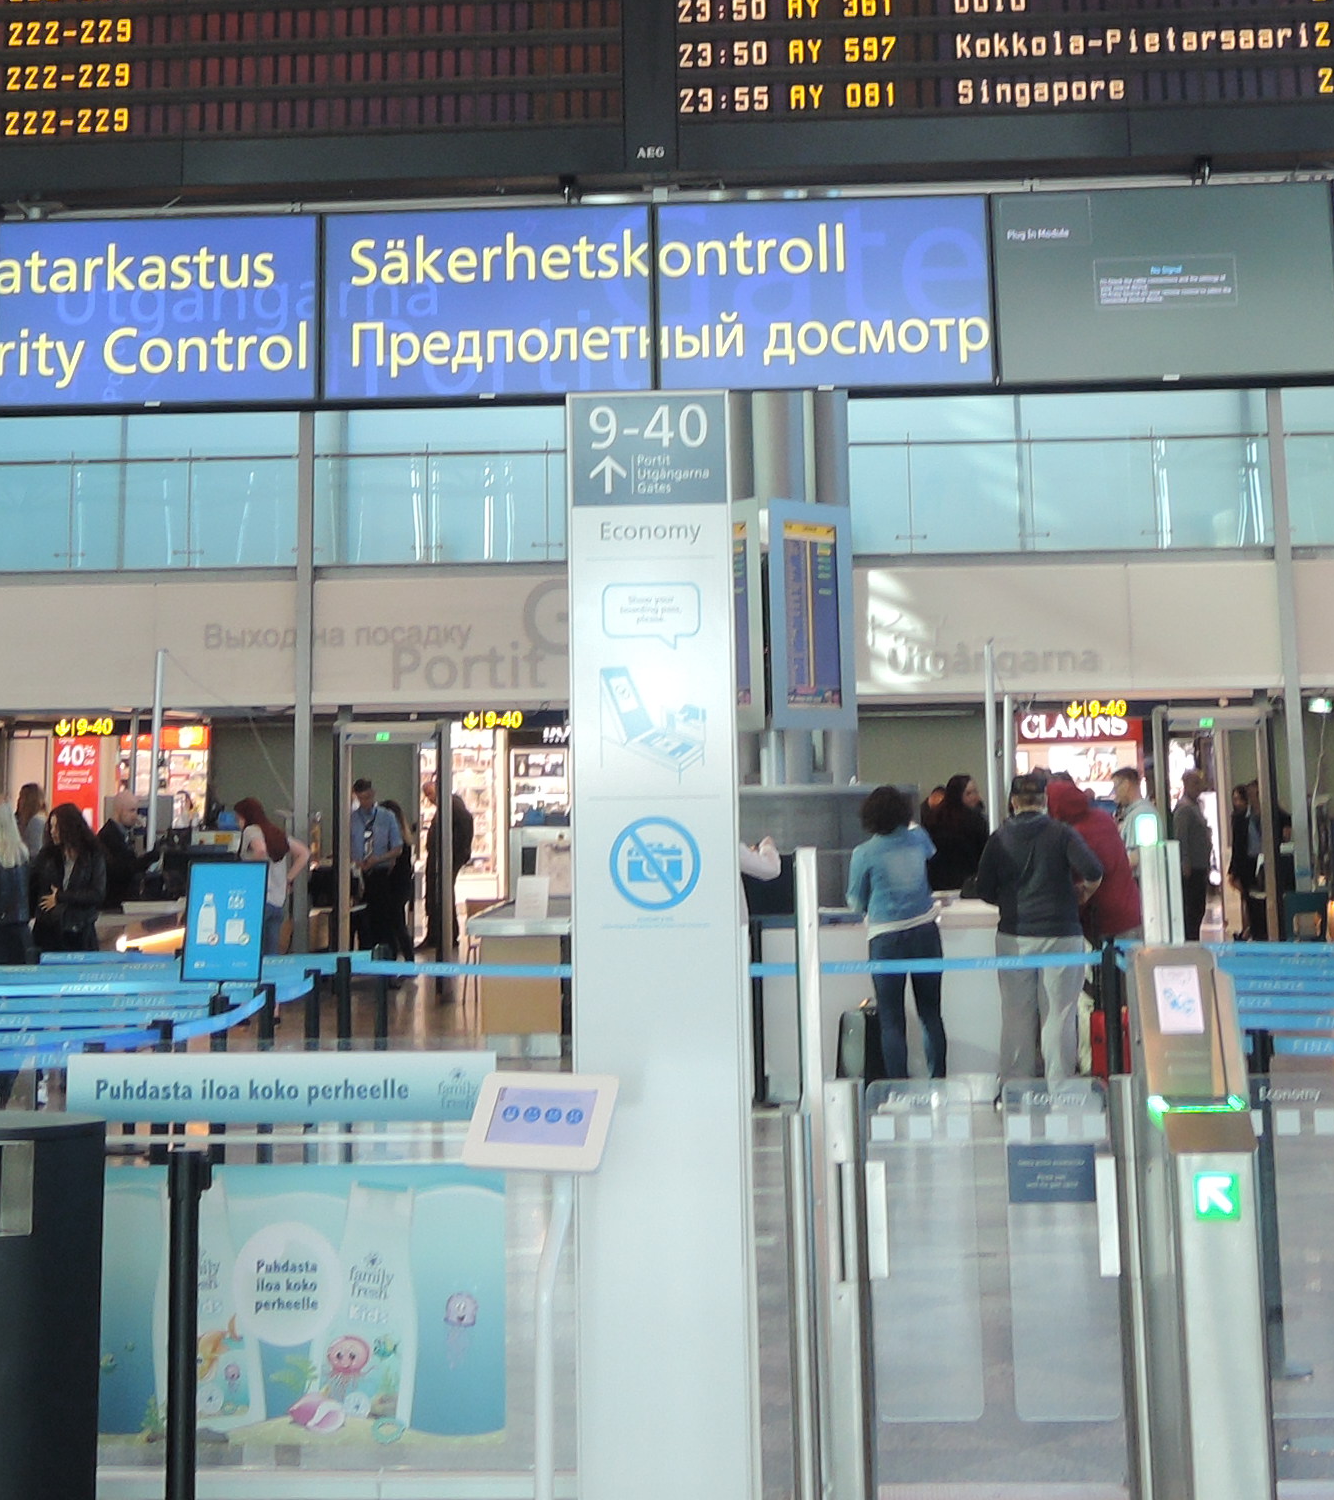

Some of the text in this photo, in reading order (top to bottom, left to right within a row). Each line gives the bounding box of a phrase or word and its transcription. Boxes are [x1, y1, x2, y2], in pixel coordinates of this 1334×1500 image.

[955, 26, 1309, 59] Kokkola-Pietarsaari
[958, 79, 1124, 107] Singapore
[637, 147, 664, 158] AEG
[351, 223, 844, 285] Säkerhetskontroll
[104, 321, 306, 374] Control
[353, 312, 989, 377] Предполетный досмотр
[590, 405, 707, 449] 9-40
[636, 454, 671, 468] Portit
[636, 466, 711, 481] Utgångarna
[637, 481, 671, 494] Gates
[600, 522, 701, 543] Economy
[204, 623, 471, 652] Выход на посадку
[392, 644, 546, 689] Portit
[1088, 700, 1127, 717] 9-40
[76, 718, 114, 735] 9-40
[485, 711, 523, 728] 9-40
[1021, 714, 1128, 739] CLARINS
[94, 1078, 410, 1106] Puhdasta iloa koko perheelle
[256, 1260, 318, 1273] Puhdasta
[256, 1279, 317, 1292] iloa koko
[255, 1297, 319, 1314] perheelle
